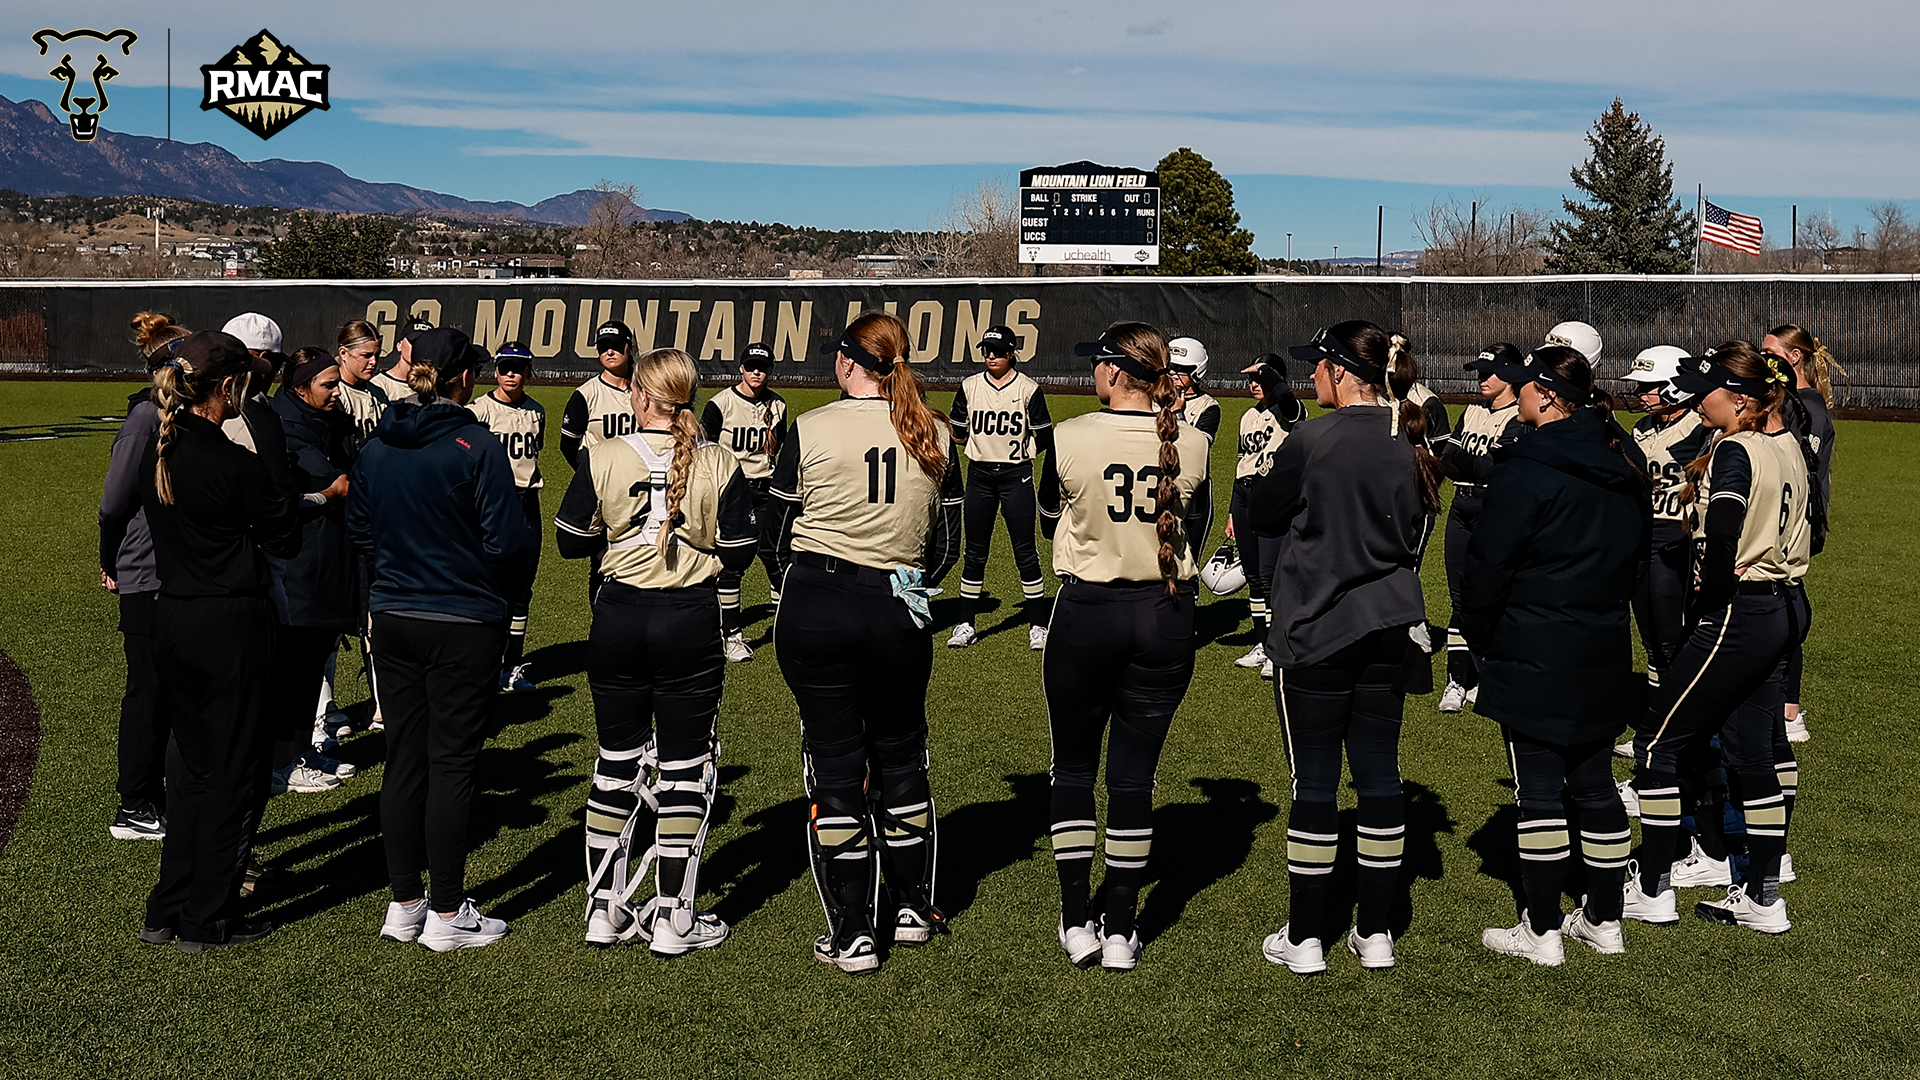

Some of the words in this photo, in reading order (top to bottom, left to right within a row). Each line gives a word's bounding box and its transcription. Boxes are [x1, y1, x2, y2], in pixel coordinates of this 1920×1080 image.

[1031, 174, 1088, 187] MOUNTAIN
[1089, 174, 1115, 187] LION
[1116, 174, 1147, 187] FIELD
[1030, 193, 1049, 203] BALL
[1071, 193, 1098, 203] STRIKE
[1124, 193, 1140, 203] OUT
[1143, 192, 1151, 204] 0
[1022, 217, 1049, 227] GUEST
[1146, 217, 1154, 229] 0
[1052, 208, 1057, 216] 1
[1063, 208, 1069, 216] 2
[1074, 208, 1080, 216] 3
[1088, 208, 1094, 216] 4
[1099, 208, 1105, 216] 5
[1110, 208, 1117, 216] 6
[1124, 208, 1129, 216] 7
[1136, 208, 1156, 217] RUNS
[1024, 231, 1046, 241] UCCS
[1146, 231, 1154, 243] 0
[1063, 248, 1112, 261] uchealth
[472, 298, 813, 362] MOUNTAIN
[845, 298, 1041, 363] ONS
[602, 413, 638, 439] UC
[972, 410, 1023, 436] UCCS
[864, 446, 896, 503] 11
[1648, 460, 1683, 488] CS
[629, 481, 686, 529] 2
[1103, 463, 1159, 523] 33
[1779, 482, 1793, 537] 6
